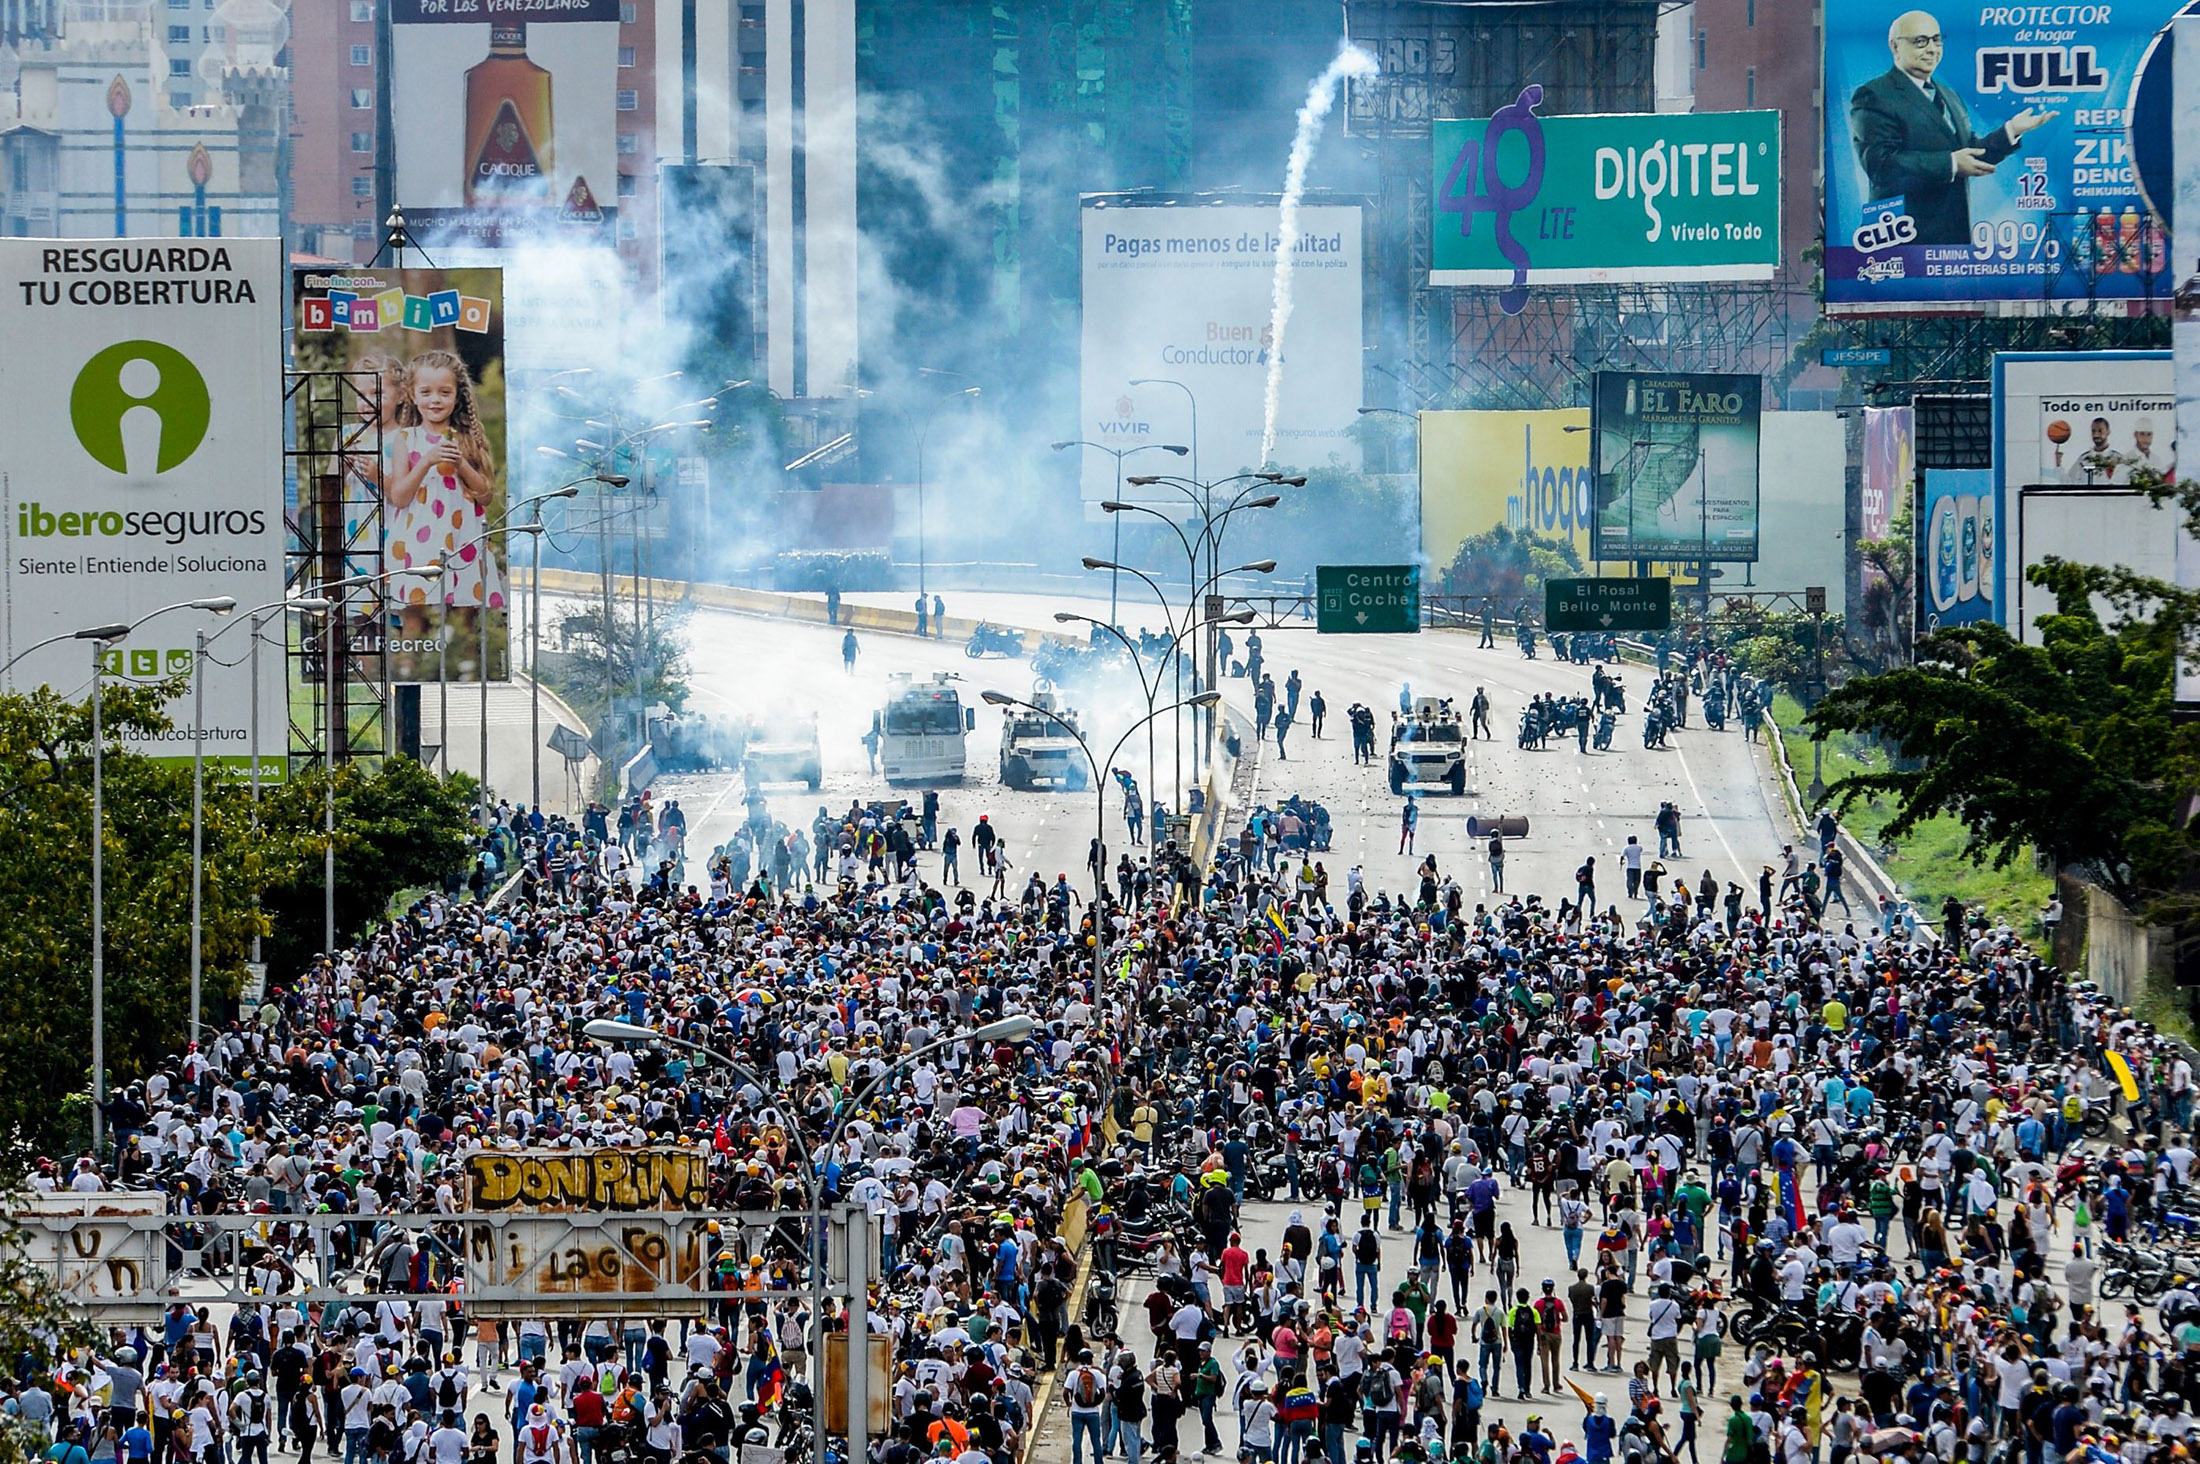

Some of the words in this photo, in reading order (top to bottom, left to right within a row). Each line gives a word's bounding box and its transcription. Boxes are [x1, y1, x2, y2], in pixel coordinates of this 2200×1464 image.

[421, 0, 448, 13] POR
[454, 0, 479, 12] LOS
[487, 0, 590, 13] VENEZOLANOS
[1980, 5, 2111, 26] PROTECTOR
[2015, 29, 2031, 42] de
[2035, 29, 2076, 44] hogar
[1980, 49, 2105, 91] FULL
[480, 162, 535, 176] CACIQUE
[2019, 174, 2047, 196] 12
[2018, 197, 2054, 208] HORAS
[410, 218, 446, 227] MUCHO
[473, 217, 494, 227] QUE
[1539, 207, 1576, 239] LTE
[1672, 223, 1719, 241] Vívelo
[1725, 222, 1762, 240] Todo
[1105, 234, 1161, 258] Pagas
[1166, 237, 1230, 252] menos
[1236, 232, 1260, 252] de
[1265, 232, 1281, 252] la
[1926, 250, 1969, 262] ELIMINA
[1972, 220, 2060, 261] 99%
[43, 248, 232, 273] RESGUARDA
[1927, 264, 1943, 276] DE
[1944, 263, 2007, 276] BACTERIAS
[2010, 263, 2025, 274] EN
[19, 281, 60, 305] TU
[69, 279, 256, 305] COBERTURA
[306, 295, 486, 329] bambino
[1206, 322, 1253, 341] Buen
[1162, 344, 1254, 365] Conductor
[1833, 352, 1881, 362] JESSIPE
[1678, 389, 1743, 414] FARO
[2042, 401, 2081, 412] Todo
[2085, 401, 2104, 412] en
[2109, 399, 2176, 412] Uniform
[1099, 422, 1150, 434] VIVIR
[19, 503, 265, 544] iberoseguros
[19, 557, 76, 575] Siente
[87, 555, 168, 573] Entiende
[178, 555, 266, 573] Soluciona
[1347, 573, 1412, 587] Centro
[1577, 584, 1592, 596] El
[1599, 583, 1639, 596] Rosal
[1329, 597, 1337, 609] 9
[1350, 592, 1409, 606] Coche
[1560, 600, 1600, 612] Bello
[1609, 599, 1657, 612] Monte
[1533, 1160, 1545, 1172] 18
[466, 1153, 587, 1210] DON
[928, 1369, 938, 1381] 7
